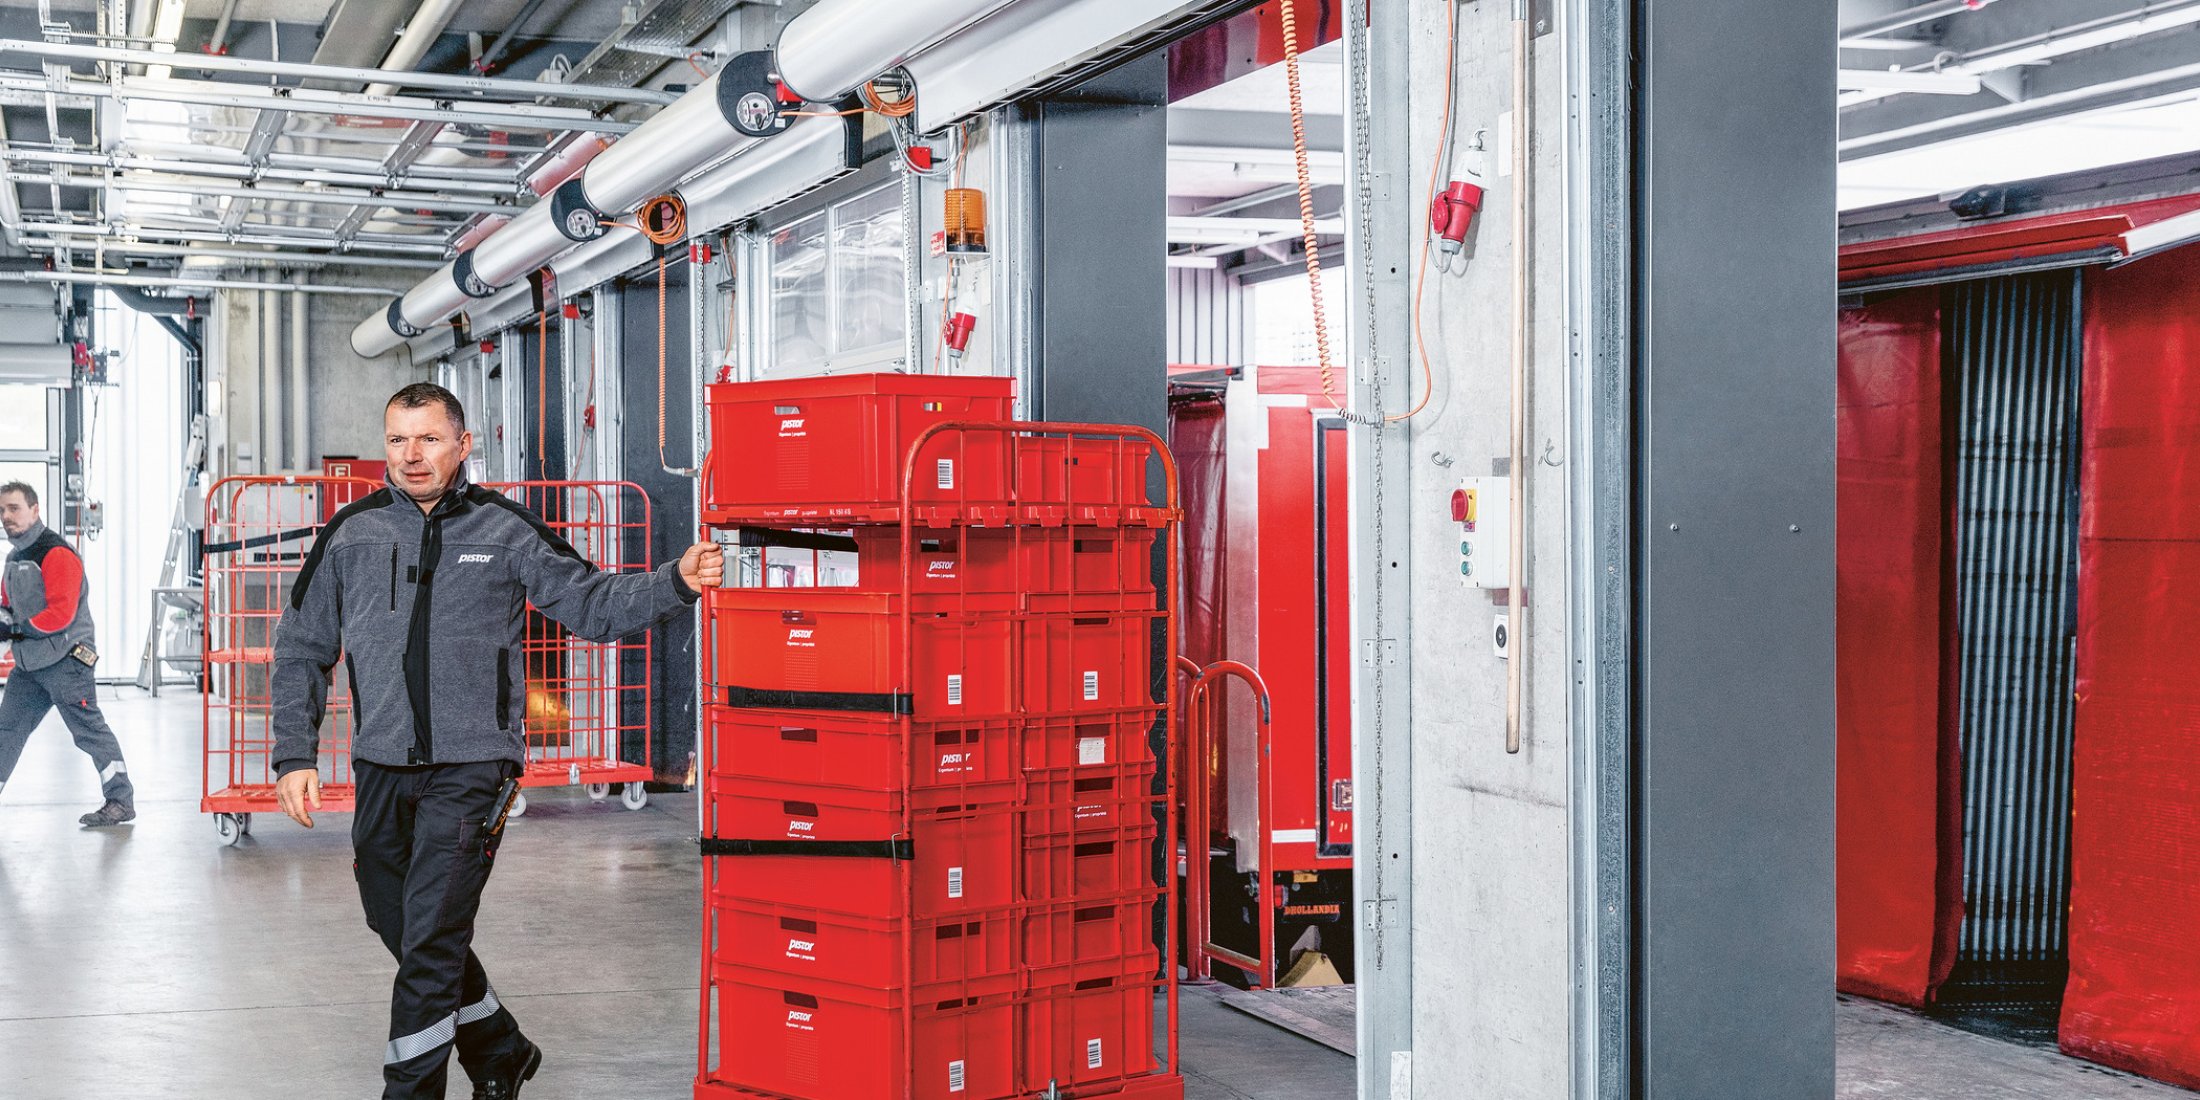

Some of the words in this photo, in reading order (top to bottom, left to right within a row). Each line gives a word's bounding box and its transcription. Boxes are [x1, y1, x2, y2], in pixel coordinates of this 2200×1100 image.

[781, 419, 805, 431] pistor
[458, 554, 494, 564] pistor
[929, 561, 954, 571] pistor
[789, 629, 813, 640] pistor
[789, 820, 814, 831] pistor
[1284, 904, 1340, 915] DHOLLANDIA
[789, 939, 815, 951] pistor
[788, 1010, 812, 1022] pistor
